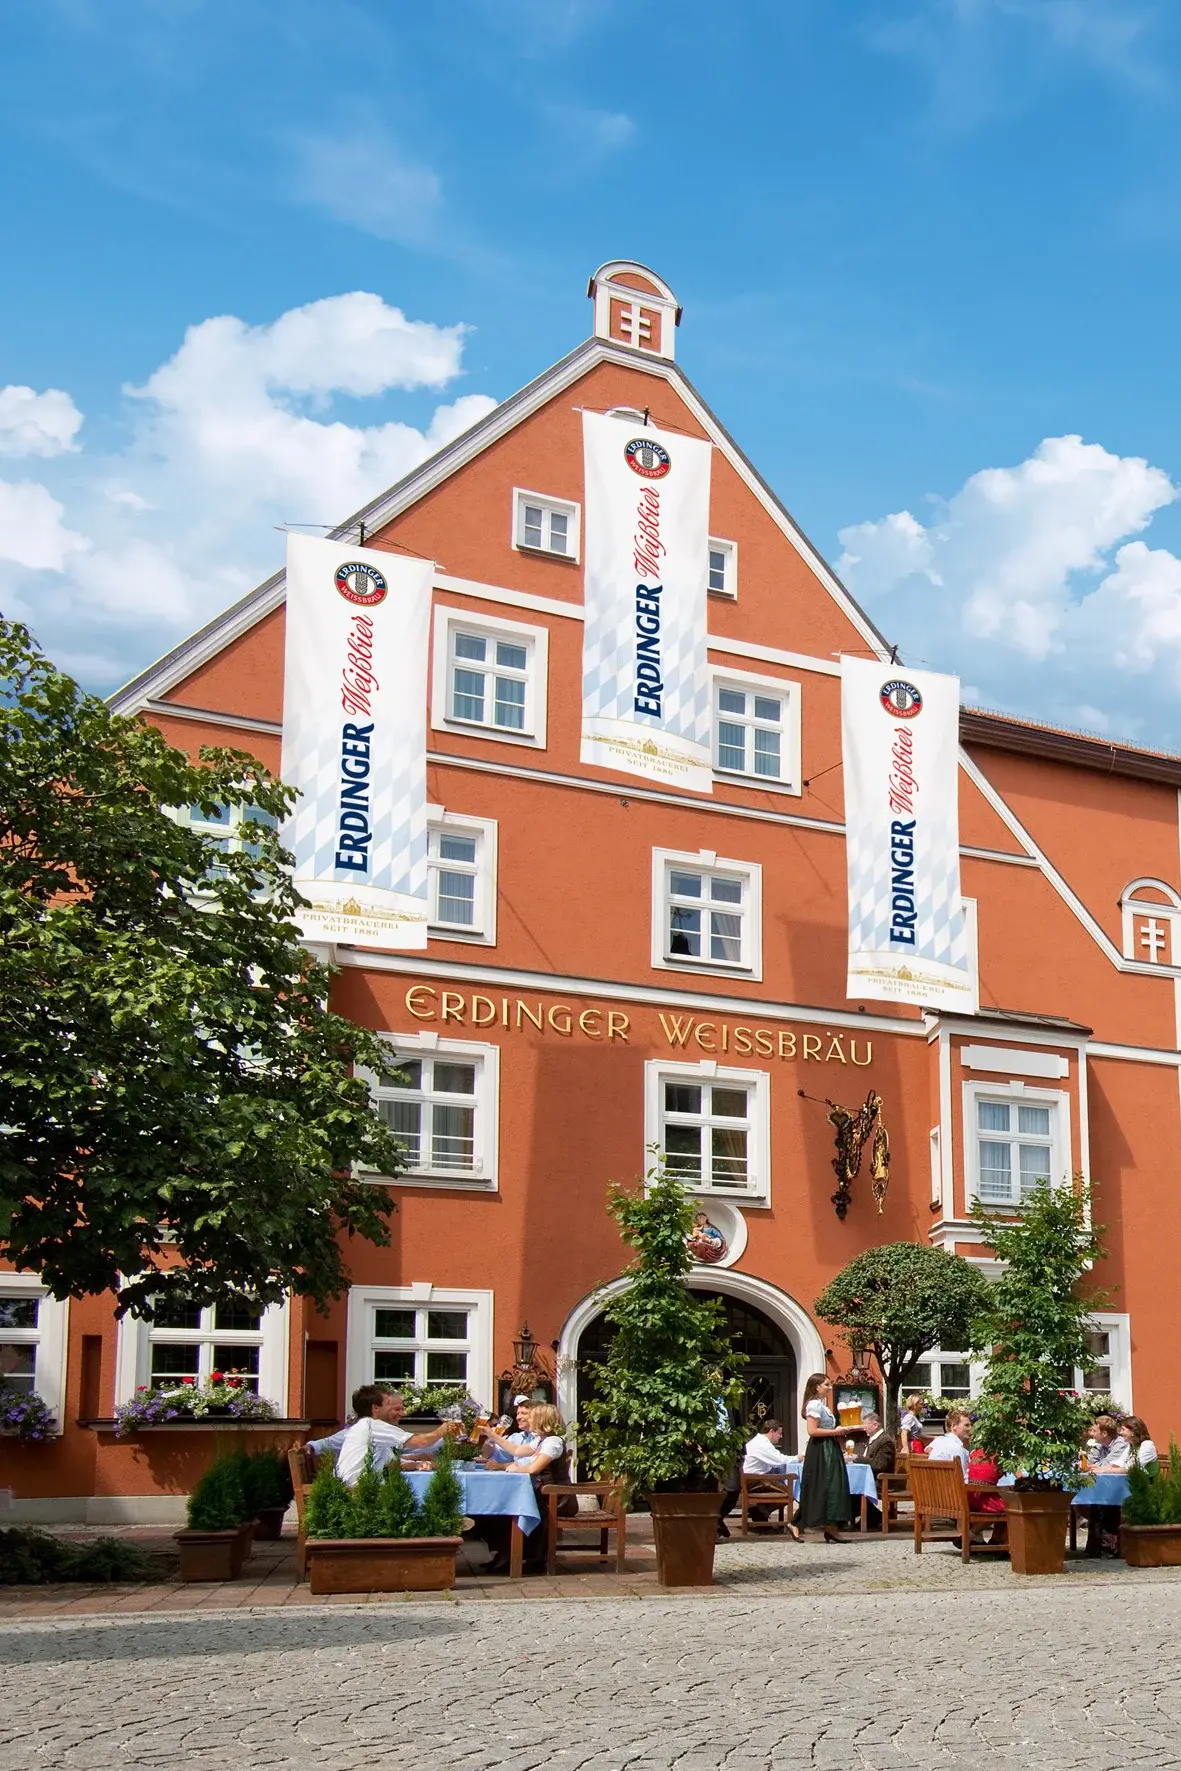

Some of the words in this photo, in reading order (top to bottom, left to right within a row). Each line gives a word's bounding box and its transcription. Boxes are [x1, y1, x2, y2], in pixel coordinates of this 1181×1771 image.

[628, 441, 667, 460] ERDINGER
[632, 486, 667, 580] Weißbier
[338, 564, 383, 585] ERDINGER
[341, 614, 379, 717] Weißbier
[634, 582, 664, 719] ERDINGER
[883, 682, 919, 700] ERDINGER
[608, 746, 689, 772] PRIVATBRAUEREI
[627, 758, 648, 769] SEIT
[889, 726, 919, 815] Weißbier
[335, 722, 375, 873] ERDINGER
[890, 819, 918, 946] ERDINGER
[302, 913, 399, 930] PRIVATBRAUEREI
[322, 924, 349, 933] SEIT
[354, 927, 379, 937] 1886
[404, 985, 630, 1040] ERDINGER
[658, 1013, 874, 1067] WEISSBRÄU
